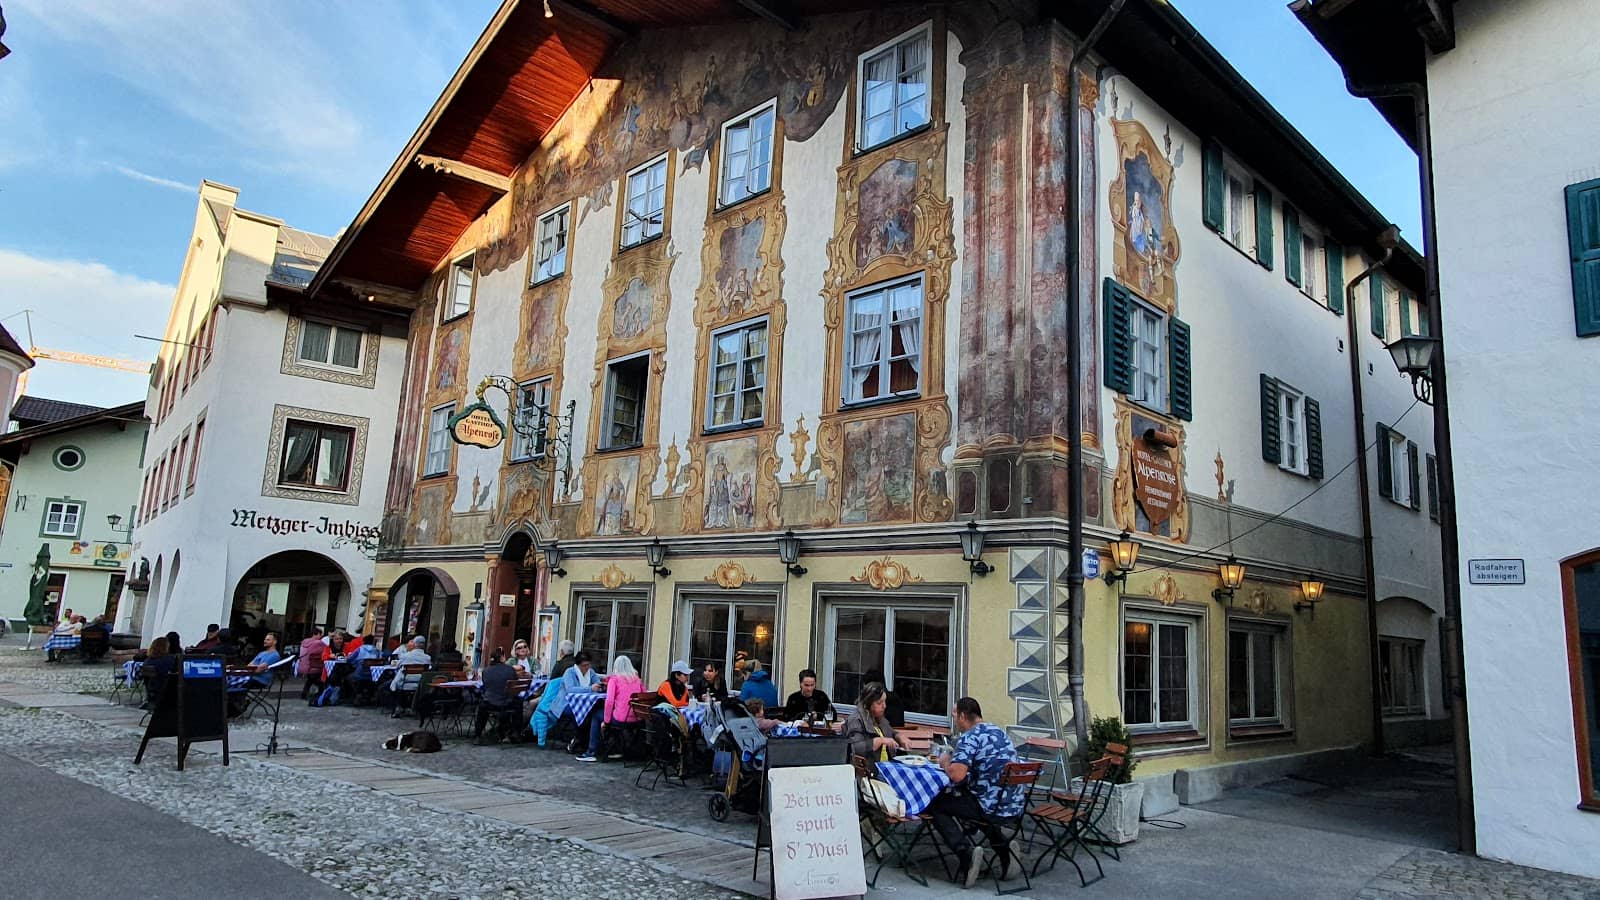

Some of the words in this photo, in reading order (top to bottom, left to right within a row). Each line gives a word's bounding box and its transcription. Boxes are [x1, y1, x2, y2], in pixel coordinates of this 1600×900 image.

[1137, 460, 1176, 485] Alpenrose
[230, 508, 381, 538] Metzger-Imbiss
[784, 790, 810, 808] Bei
[815, 793, 843, 806] uns
[796, 814, 835, 835] spuit
[805, 839, 849, 858] Musi
